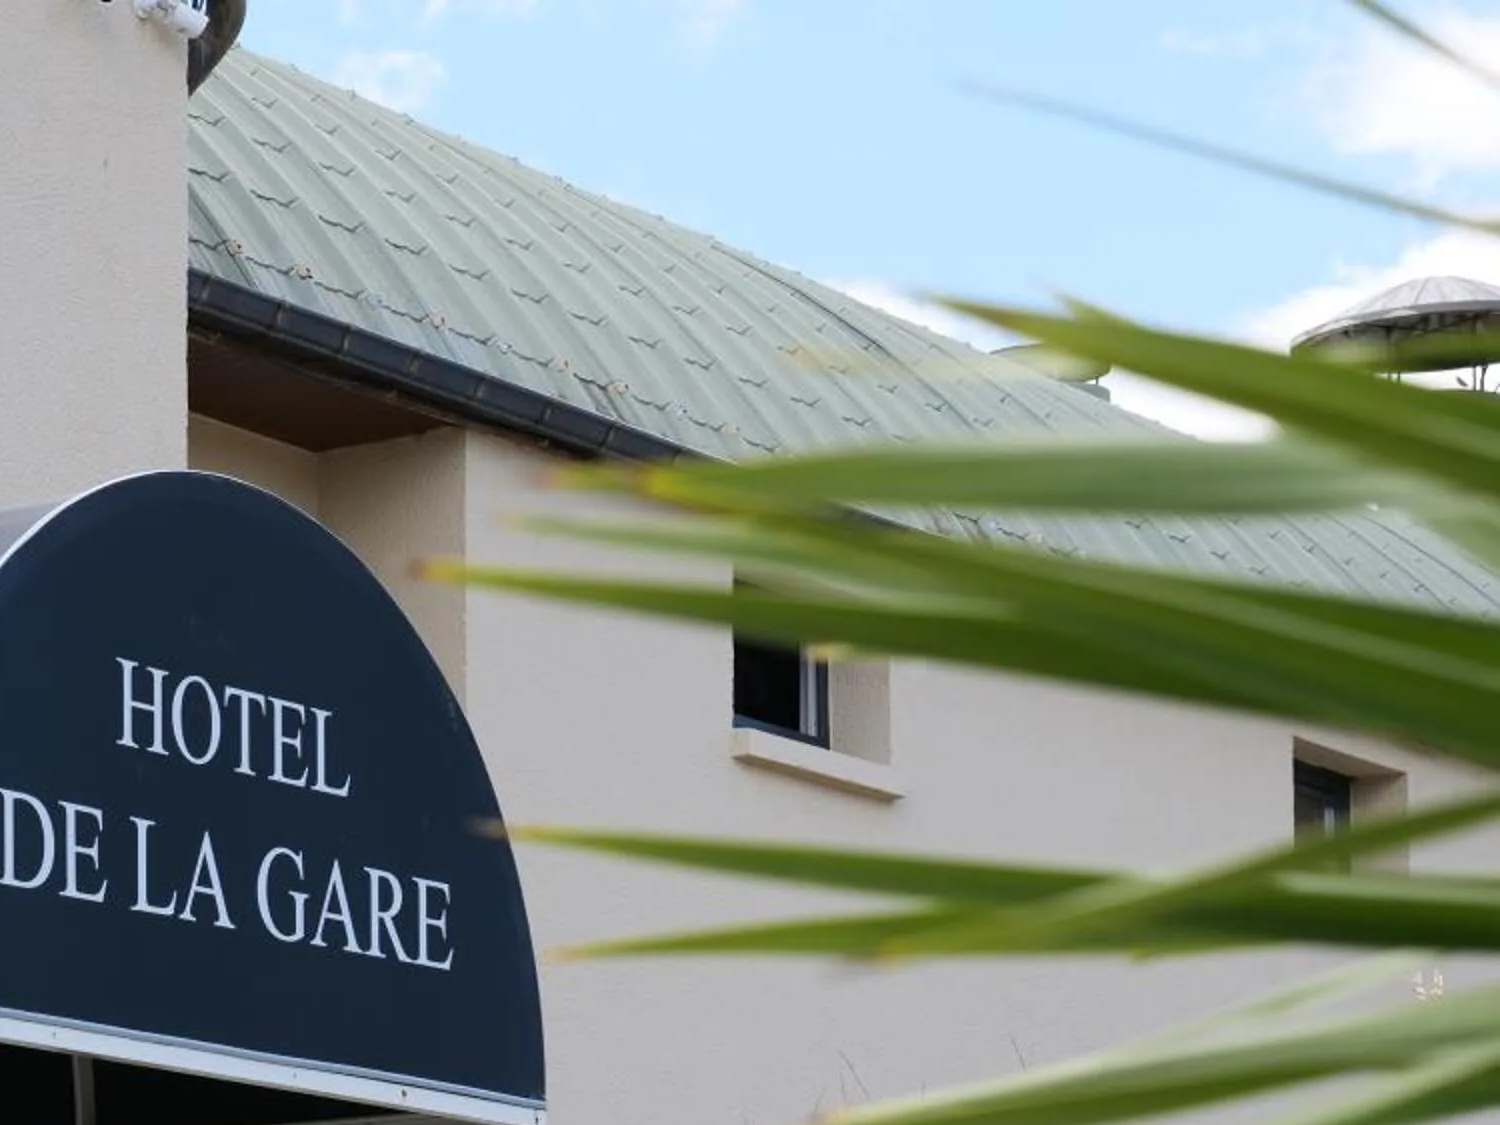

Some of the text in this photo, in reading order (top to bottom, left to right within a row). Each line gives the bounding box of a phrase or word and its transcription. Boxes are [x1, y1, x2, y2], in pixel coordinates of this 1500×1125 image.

[116, 656, 351, 797] HOTEL
[128, 815, 236, 930] LA
[257, 846, 455, 971] GARE
